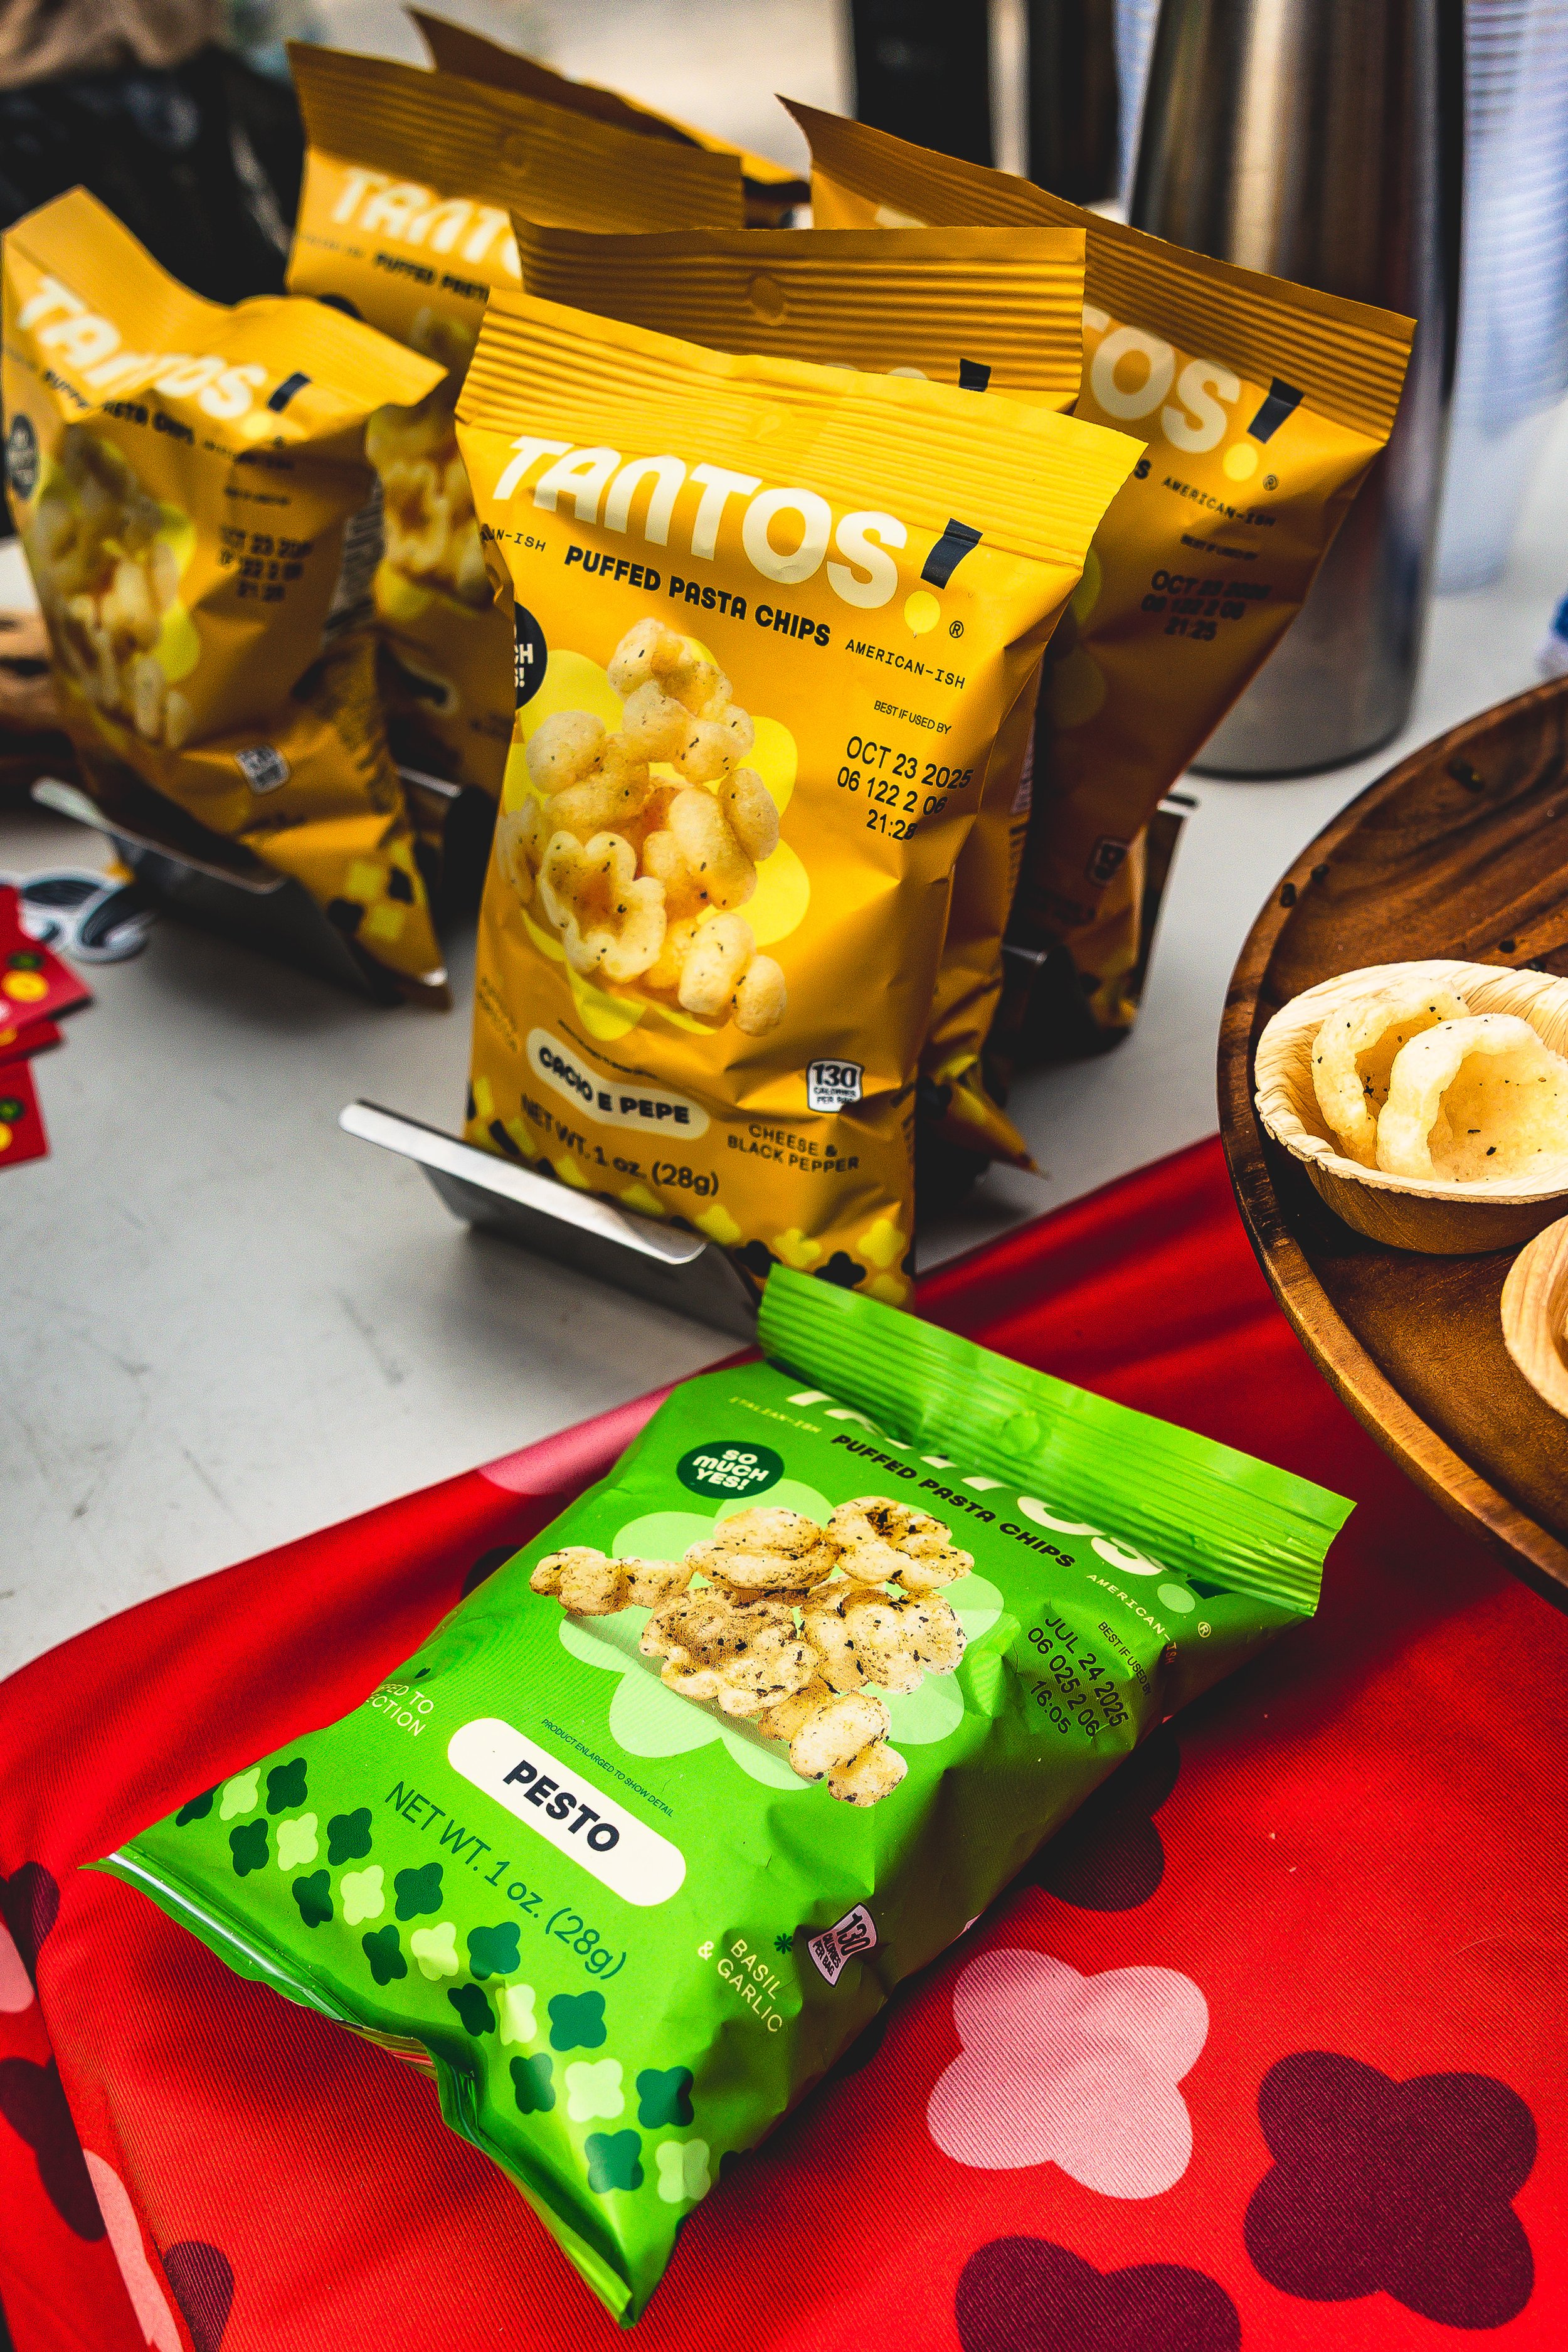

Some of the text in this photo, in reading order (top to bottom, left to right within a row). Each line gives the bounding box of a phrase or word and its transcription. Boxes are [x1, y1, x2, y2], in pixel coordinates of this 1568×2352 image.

[493, 435, 983, 636] TANTOS!
[1151, 569, 1198, 595] OCT
[564, 544, 966, 689] PUFFED PASTA CHIPS AMERICAN-ISH
[874, 700, 952, 734] BEST IF USED BY
[847, 736, 974, 790] OCT 23 2025
[837, 766, 948, 815] 06 122 2 06
[866, 808, 918, 841] 21:28
[539, 1046, 594, 1101] CACIO
[597, 1092, 613, 1111] E
[620, 1096, 690, 1124] PEPE
[813, 1063, 858, 1088] 130
[521, 1093, 552, 1131] NET
[595, 1145, 608, 1167] 1
[652, 1161, 719, 1197] (28g)
[728, 1134, 860, 1173] BLACK PEPPER
[749, 1124, 838, 1158] CHEESE &
[692, 1455, 770, 1481] MUCH
[696, 1468, 751, 1491] YES!
[722, 1449, 758, 1465] SO
[830, 1434, 1076, 1567] PUFFED PASTA CHIPS
[1086, 1574, 1177, 1665] AMERICAN-ISH
[1045, 1617, 1129, 1727] JUL 24 2025
[1098, 1621, 1123, 1648] BEST
[1118, 1645, 1131, 1657] IF
[1126, 1655, 1148, 1685] USED
[409, 1690, 434, 1714] TO
[1027, 1627, 1099, 1737] 06 025 2 06
[1030, 1680, 1071, 1734] 16:05
[541, 1719, 675, 1818] PRODUCT ENLARGED TO SHOW DETAIL
[502, 1759, 620, 1852] PESTO
[384, 1781, 627, 1980] NET WT. 1 oz. (28g)
[812, 1940, 835, 1978] PER BAG
[822, 1932, 842, 1969] CALORIES
[837, 1912, 872, 1957] 130
[697, 1941, 783, 2033] & GARLIC
[730, 1939, 781, 2000] BASIL
